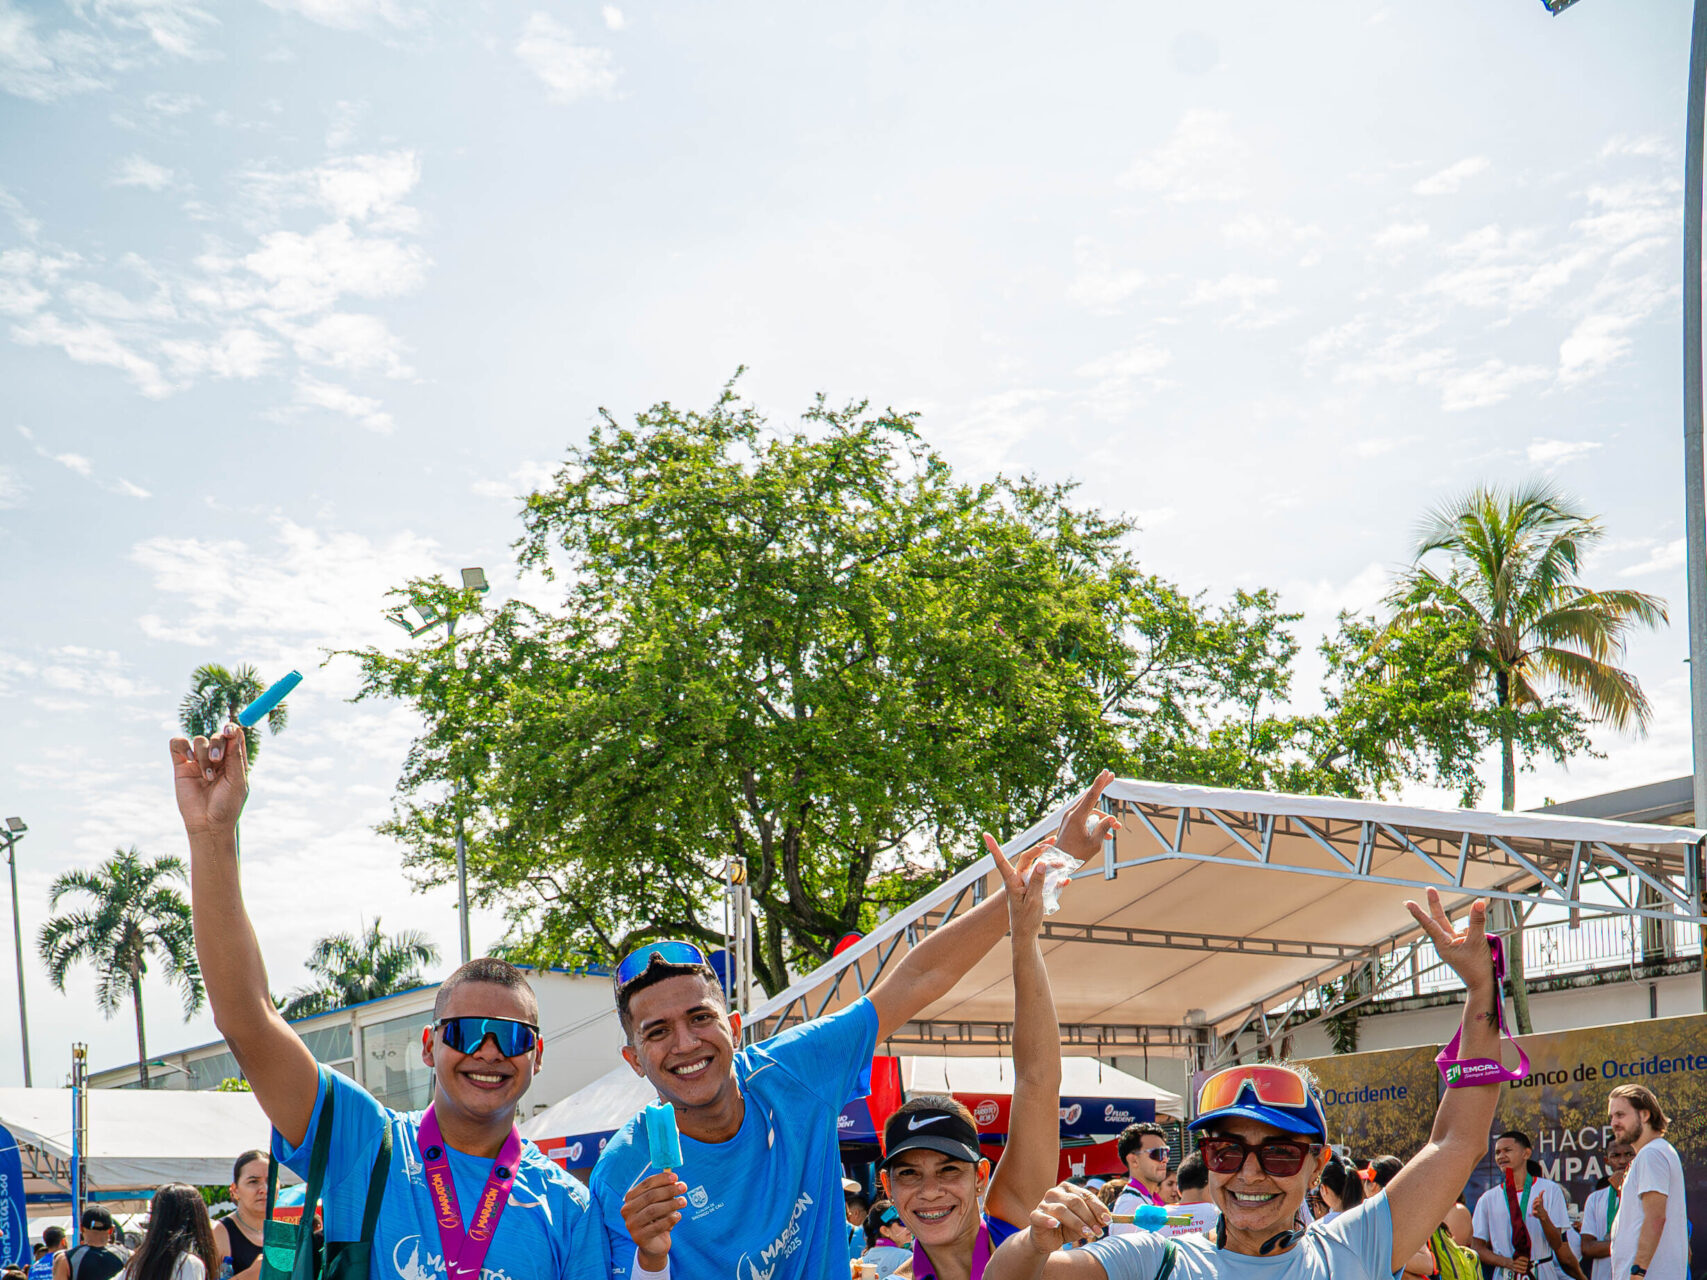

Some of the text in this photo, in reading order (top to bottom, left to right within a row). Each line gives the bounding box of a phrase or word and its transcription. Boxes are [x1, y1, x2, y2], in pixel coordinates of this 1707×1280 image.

[1574, 1063, 1597, 1082] de
[1602, 1054, 1707, 1079] Occidente
[1325, 1085, 1408, 1106] Occidente
